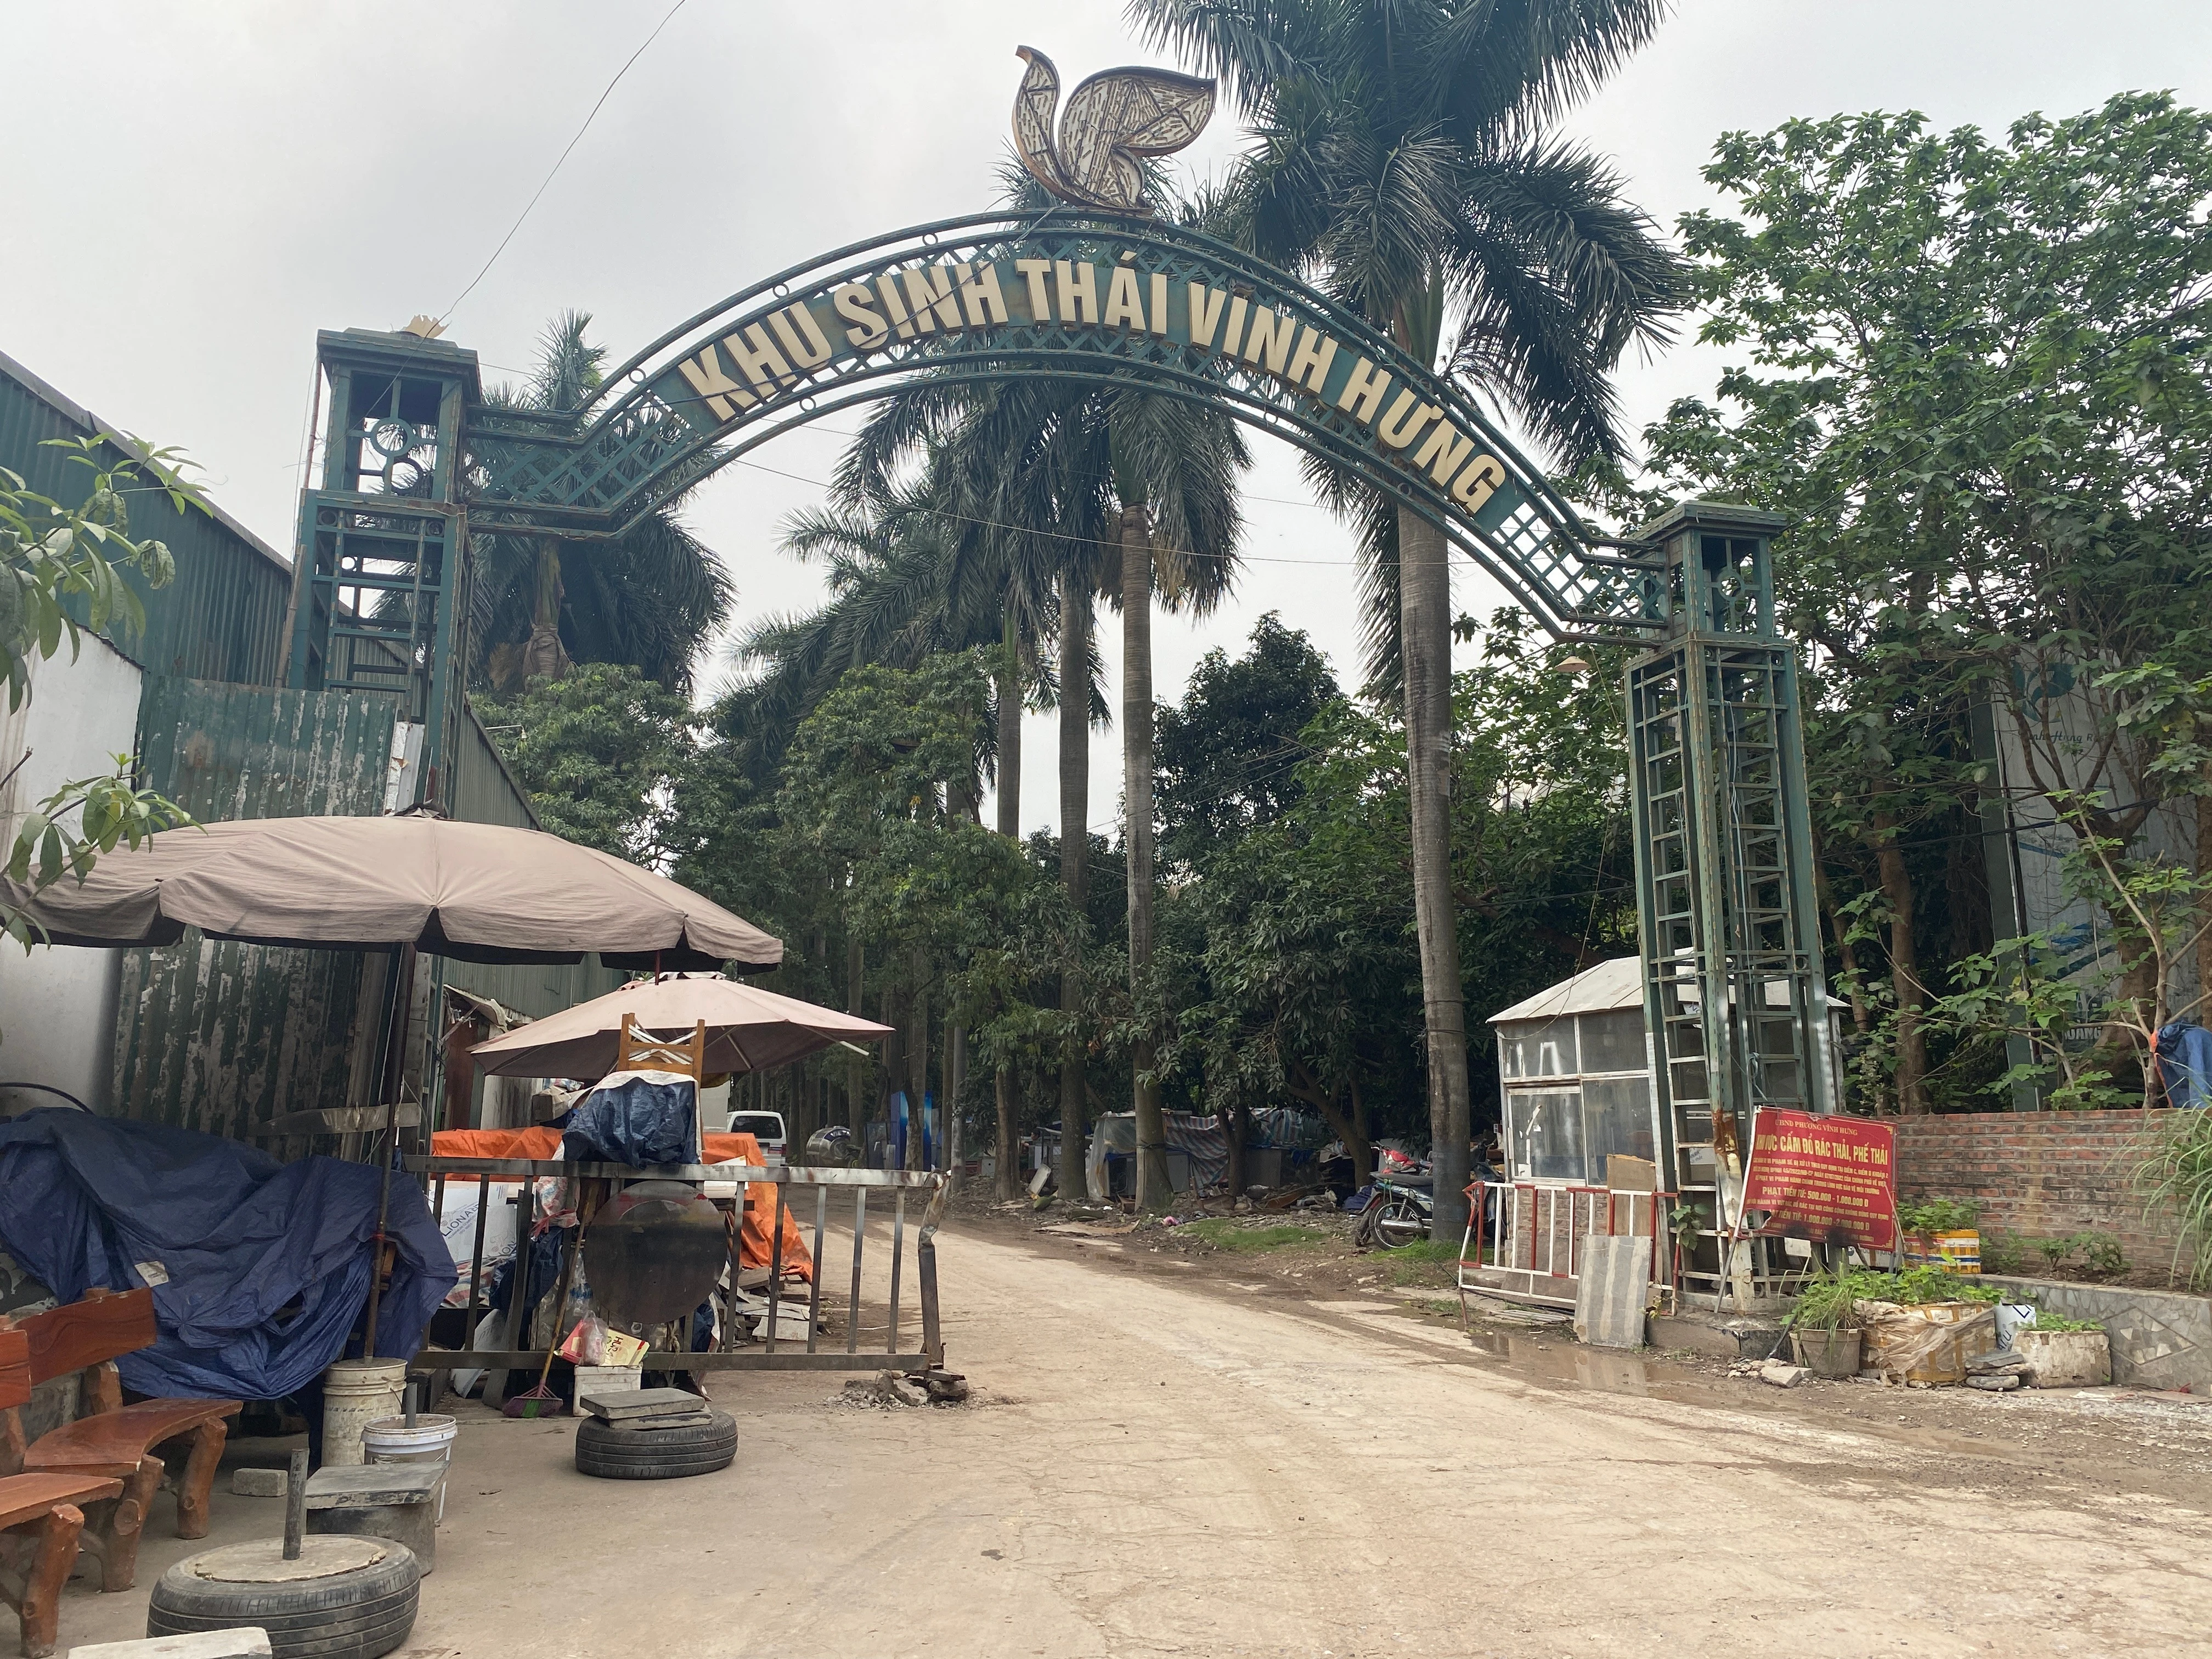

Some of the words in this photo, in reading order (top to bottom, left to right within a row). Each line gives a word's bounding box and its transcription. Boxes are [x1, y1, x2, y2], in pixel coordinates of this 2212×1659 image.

[678, 301, 833, 425] KHU
[833, 261, 1009, 351] SINH
[1015, 250, 1167, 338] THÁI
[1336, 356, 1506, 517] HƯNG
[1780, 1131, 1801, 1153] CẤM
[1802, 1133, 1814, 1154] ĐỔ
[1814, 1137, 1831, 1158] RÁC
[1832, 1138, 1852, 1163] THẢI,
[1853, 1142, 1869, 1163] PHẾ
[1870, 1144, 1888, 1165] THẢI
[1763, 1187, 1781, 1197] PHẠT
[1808, 1190, 1831, 1202] 500.000
[1837, 1195, 1863, 1206] 1.000.000
[1804, 1214, 1832, 1226] 1.000.000
